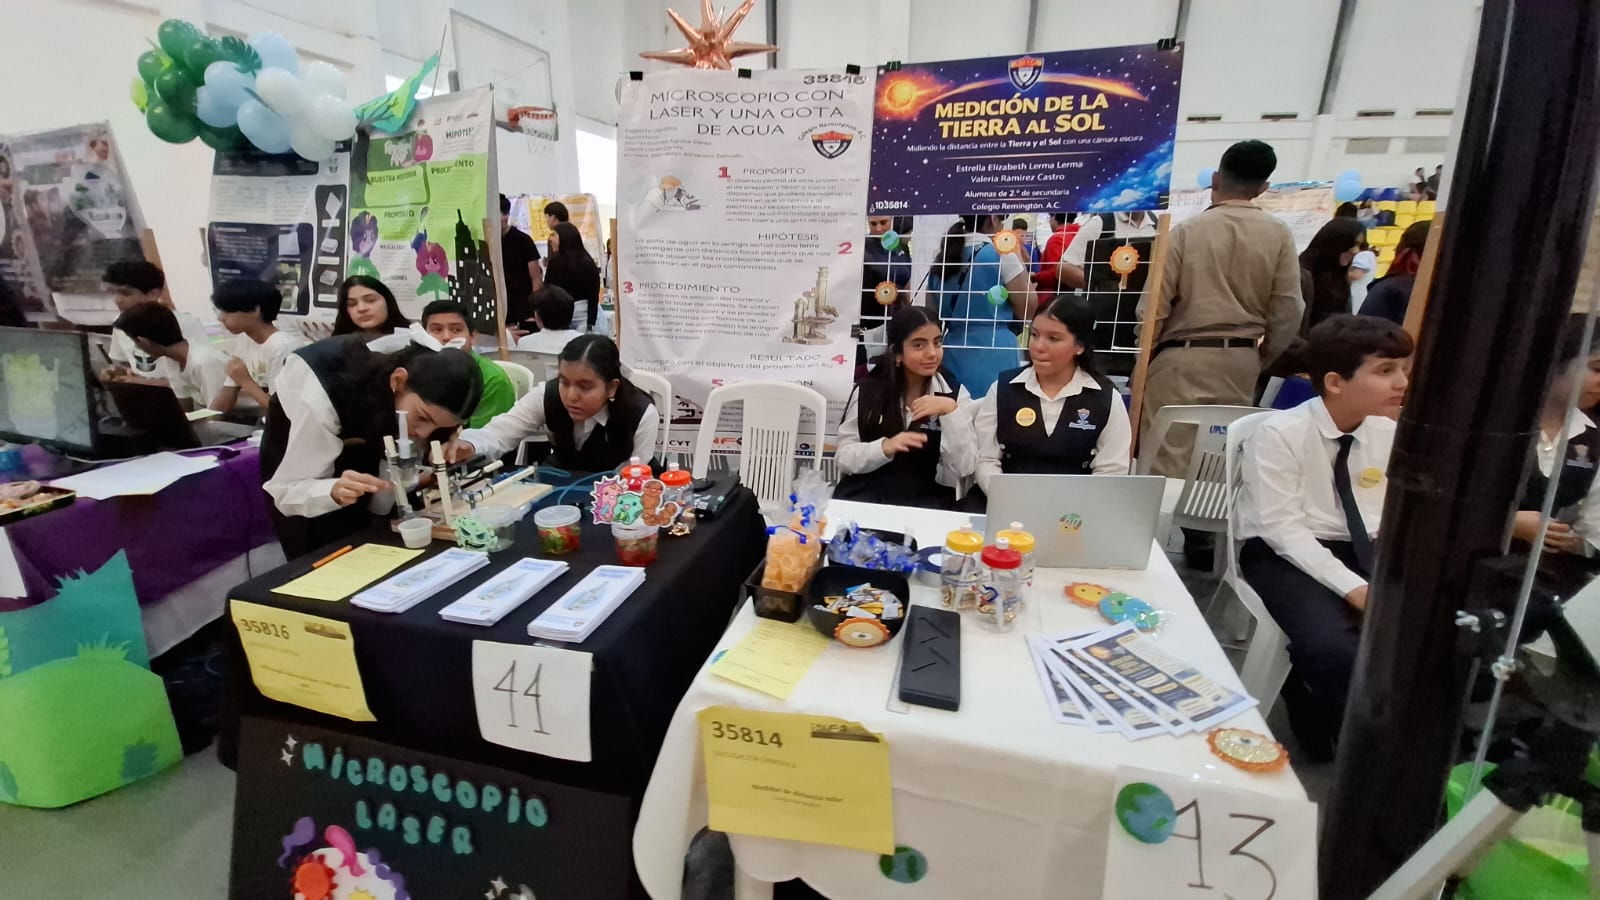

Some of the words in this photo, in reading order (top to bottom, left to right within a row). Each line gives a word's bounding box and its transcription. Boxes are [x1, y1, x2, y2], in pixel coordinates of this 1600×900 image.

[651, 90, 789, 104] MICROSCOPIO
[795, 90, 844, 101] CON
[934, 92, 1040, 119] MEDICIÓN
[1044, 95, 1074, 112] DE
[1080, 93, 1109, 110] LA
[650, 106, 704, 120] LASER
[710, 107, 725, 119] Y
[730, 107, 775, 119] UNA
[780, 106, 844, 119] GOTA
[697, 124, 721, 135] DE
[726, 124, 784, 136] AGUA
[938, 117, 1021, 138] TIERRA
[1025, 119, 1050, 134] AL
[1054, 113, 1105, 132] SOL
[906, 144, 938, 152] Midiendo
[939, 143, 946, 151] la
[946, 142, 978, 150] distancia
[1008, 139, 1032, 148] Tierra
[1032, 139, 1037, 148] y
[1039, 138, 1047, 146] el
[1048, 137, 1061, 146] Sol
[718, 166, 731, 178] 1
[743, 166, 806, 176] PROPÓSITO
[956, 163, 986, 173] Estrella
[987, 162, 1027, 172] Elizabeth
[1028, 161, 1055, 170] Lerma
[1056, 160, 1083, 169] Lerma
[971, 174, 999, 183] Valeria
[1037, 172, 1065, 181] Castro
[964, 190, 996, 198] Alumnas
[1021, 189, 1031, 197] de
[1032, 188, 1070, 197] secundaria
[971, 202, 1001, 212] Colegio
[758, 231, 820, 240] HIPÓTESIS
[837, 241, 853, 255] 2
[622, 281, 634, 293] 3
[639, 281, 741, 294] PROCEDIMIENTO
[832, 354, 847, 365] 4
[240, 618, 290, 640] 35816
[493, 659, 551, 735] 44
[711, 721, 783, 748] 35814
[355, 800, 475, 855] LASER
